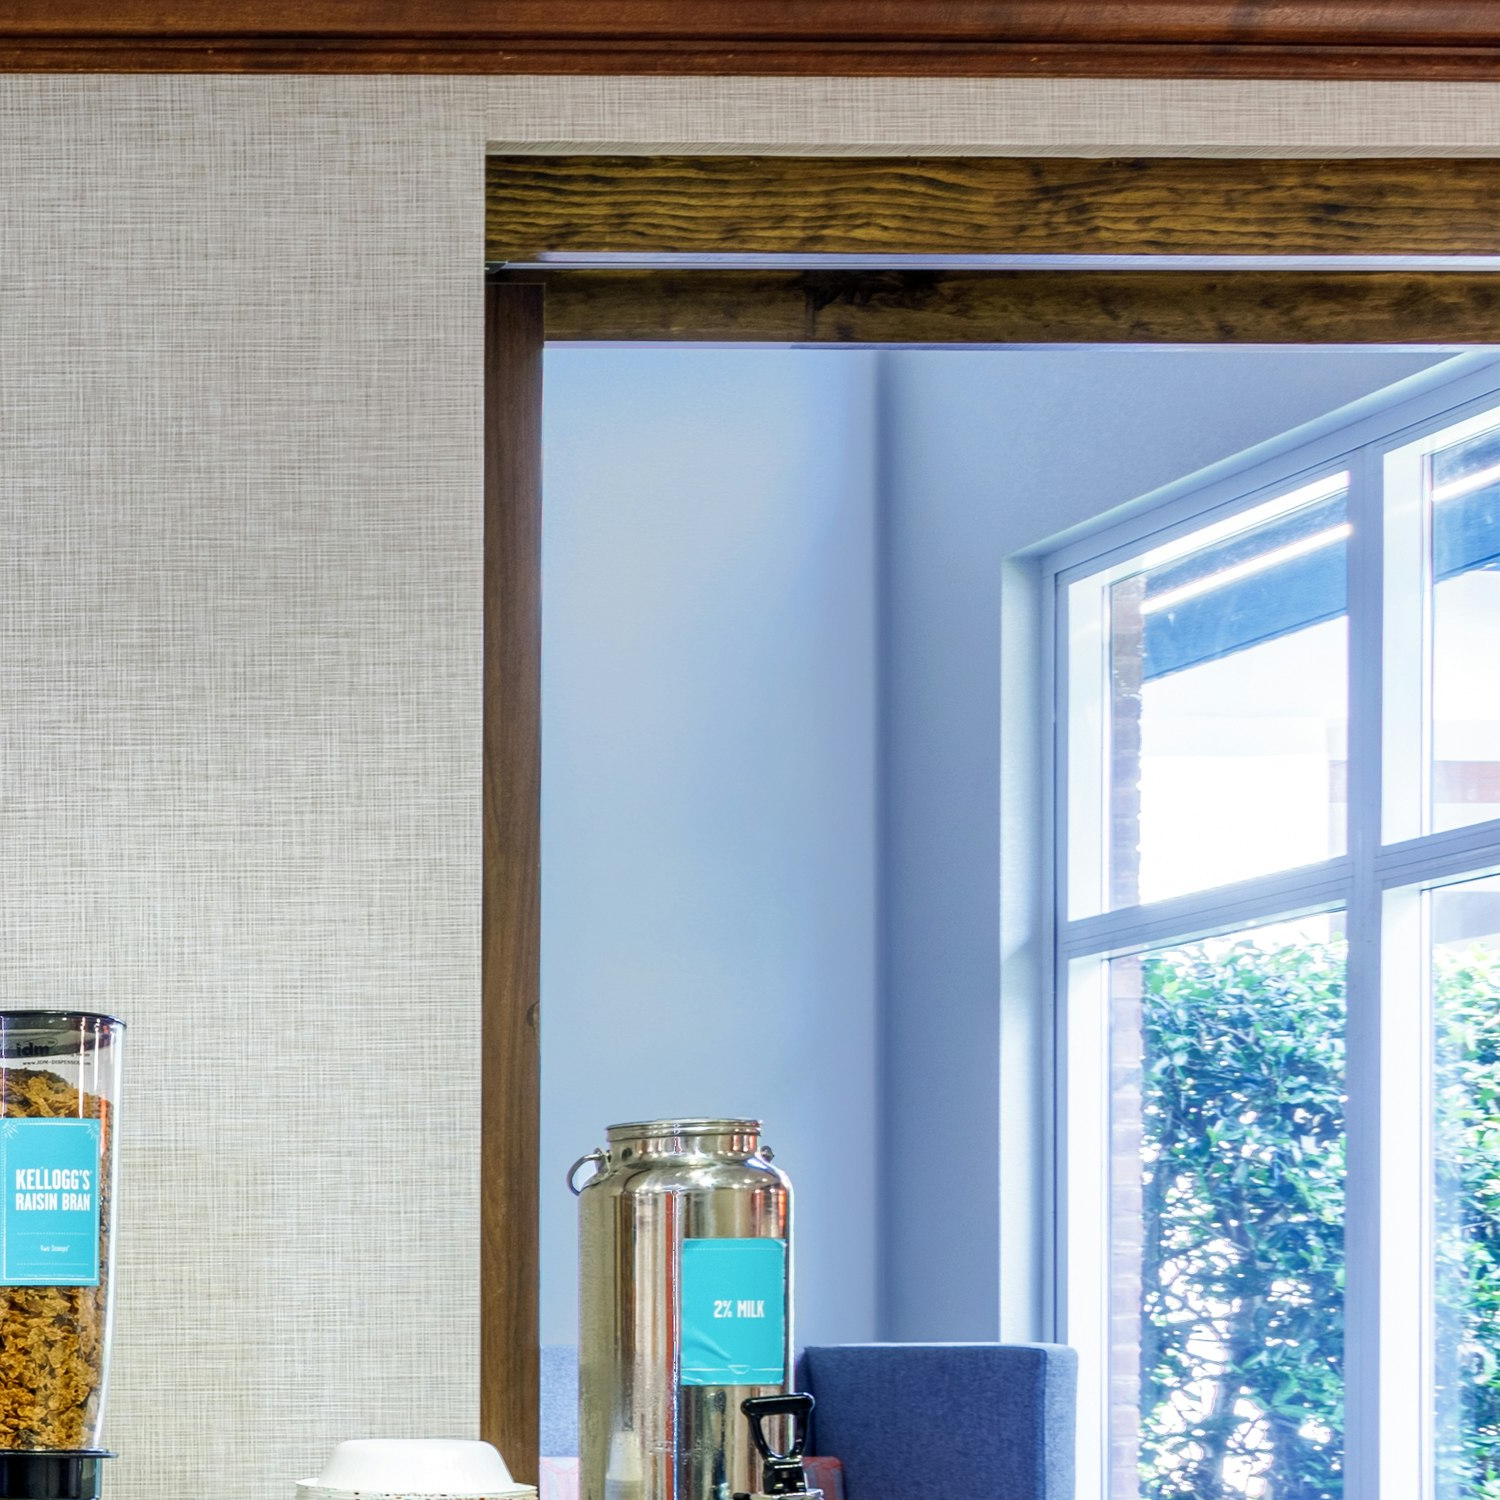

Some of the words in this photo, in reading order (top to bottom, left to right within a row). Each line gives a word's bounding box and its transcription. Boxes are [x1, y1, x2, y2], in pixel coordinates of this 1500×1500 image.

[15, 1168, 91, 1190] KELLOGG'S
[15, 1192, 58, 1211] RAISIN
[62, 1192, 91, 1211] BRAN
[713, 1299, 732, 1318] 2%
[737, 1300, 765, 1318] MILK
